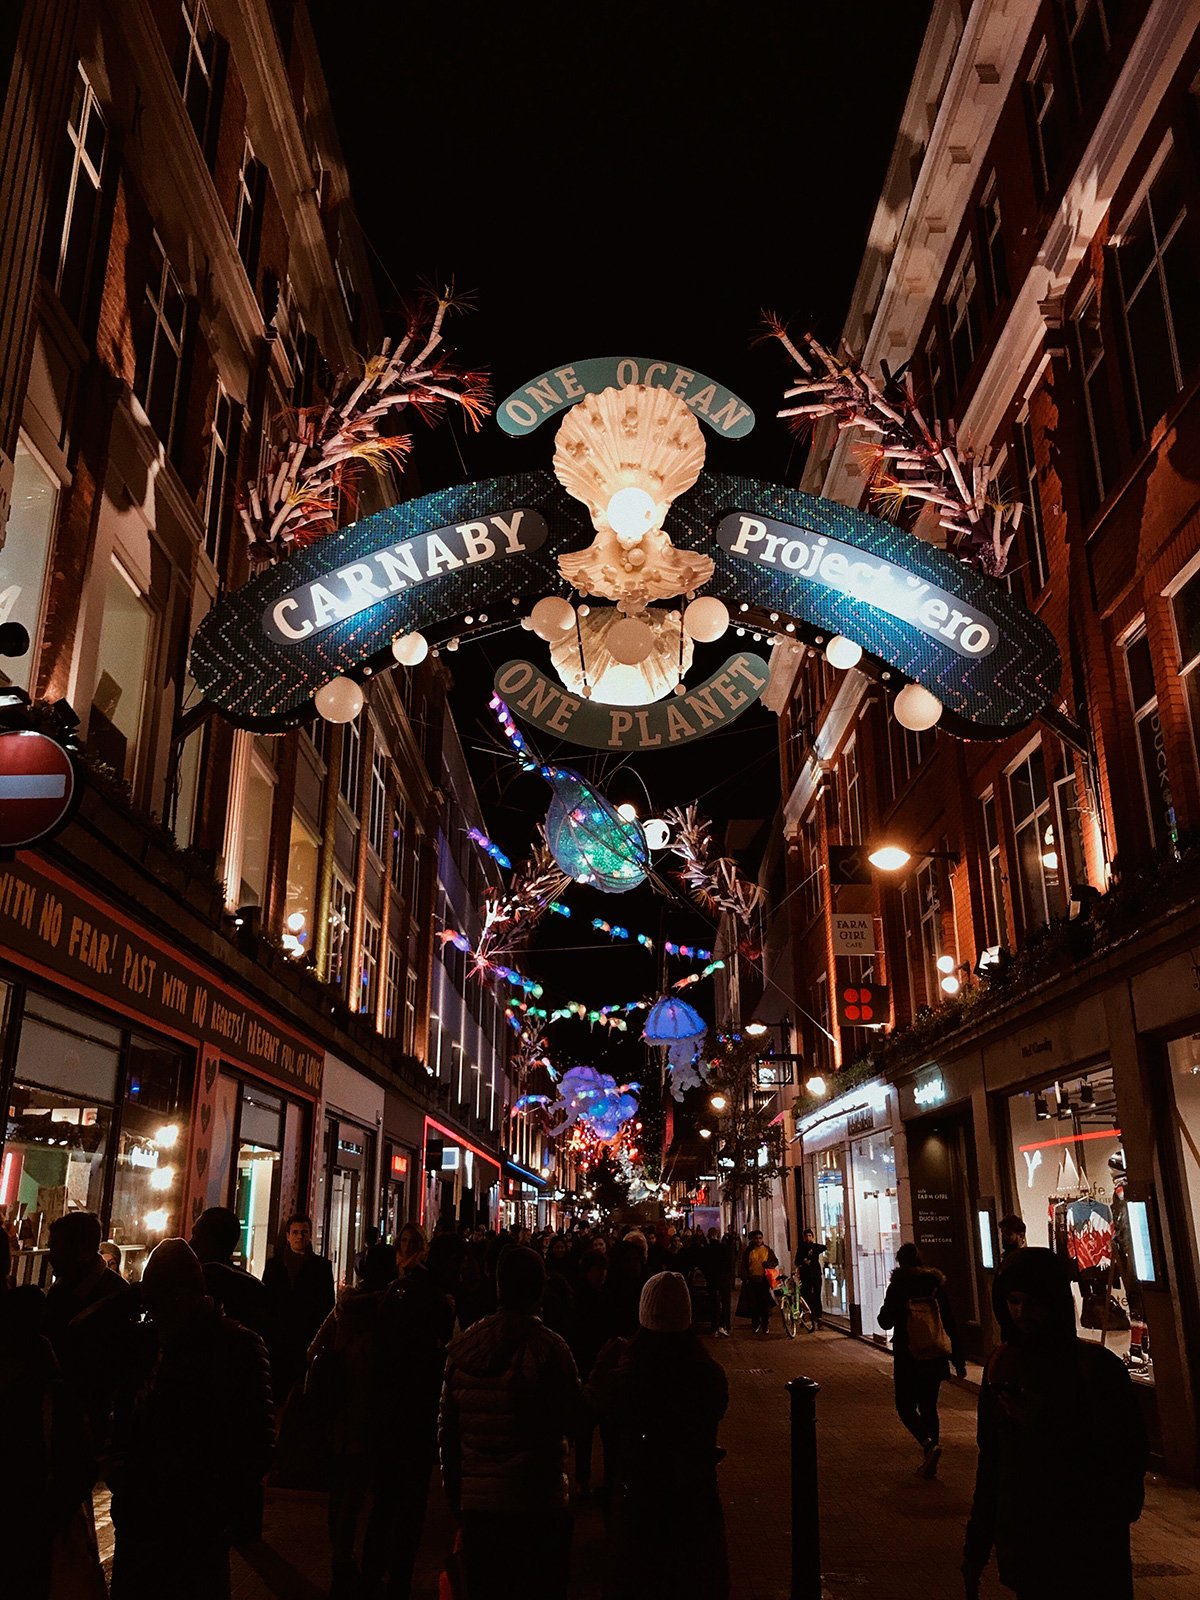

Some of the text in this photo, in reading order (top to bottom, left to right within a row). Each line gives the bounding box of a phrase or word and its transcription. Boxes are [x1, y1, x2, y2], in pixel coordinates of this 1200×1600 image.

[505, 359, 751, 432] ONE OCEAN
[272, 511, 527, 640] CARNABY
[499, 655, 766, 747] ONE PLANET
[837, 920, 868, 929] FARM
[839, 930, 866, 940] GIRL
[38, 892, 63, 948] NO
[68, 915, 119, 975] FEAR!
[122, 943, 157, 998] PAST
[161, 971, 188, 1015] WITH
[192, 985, 208, 1029] NO
[247, 1020, 280, 1064] PRESENT
